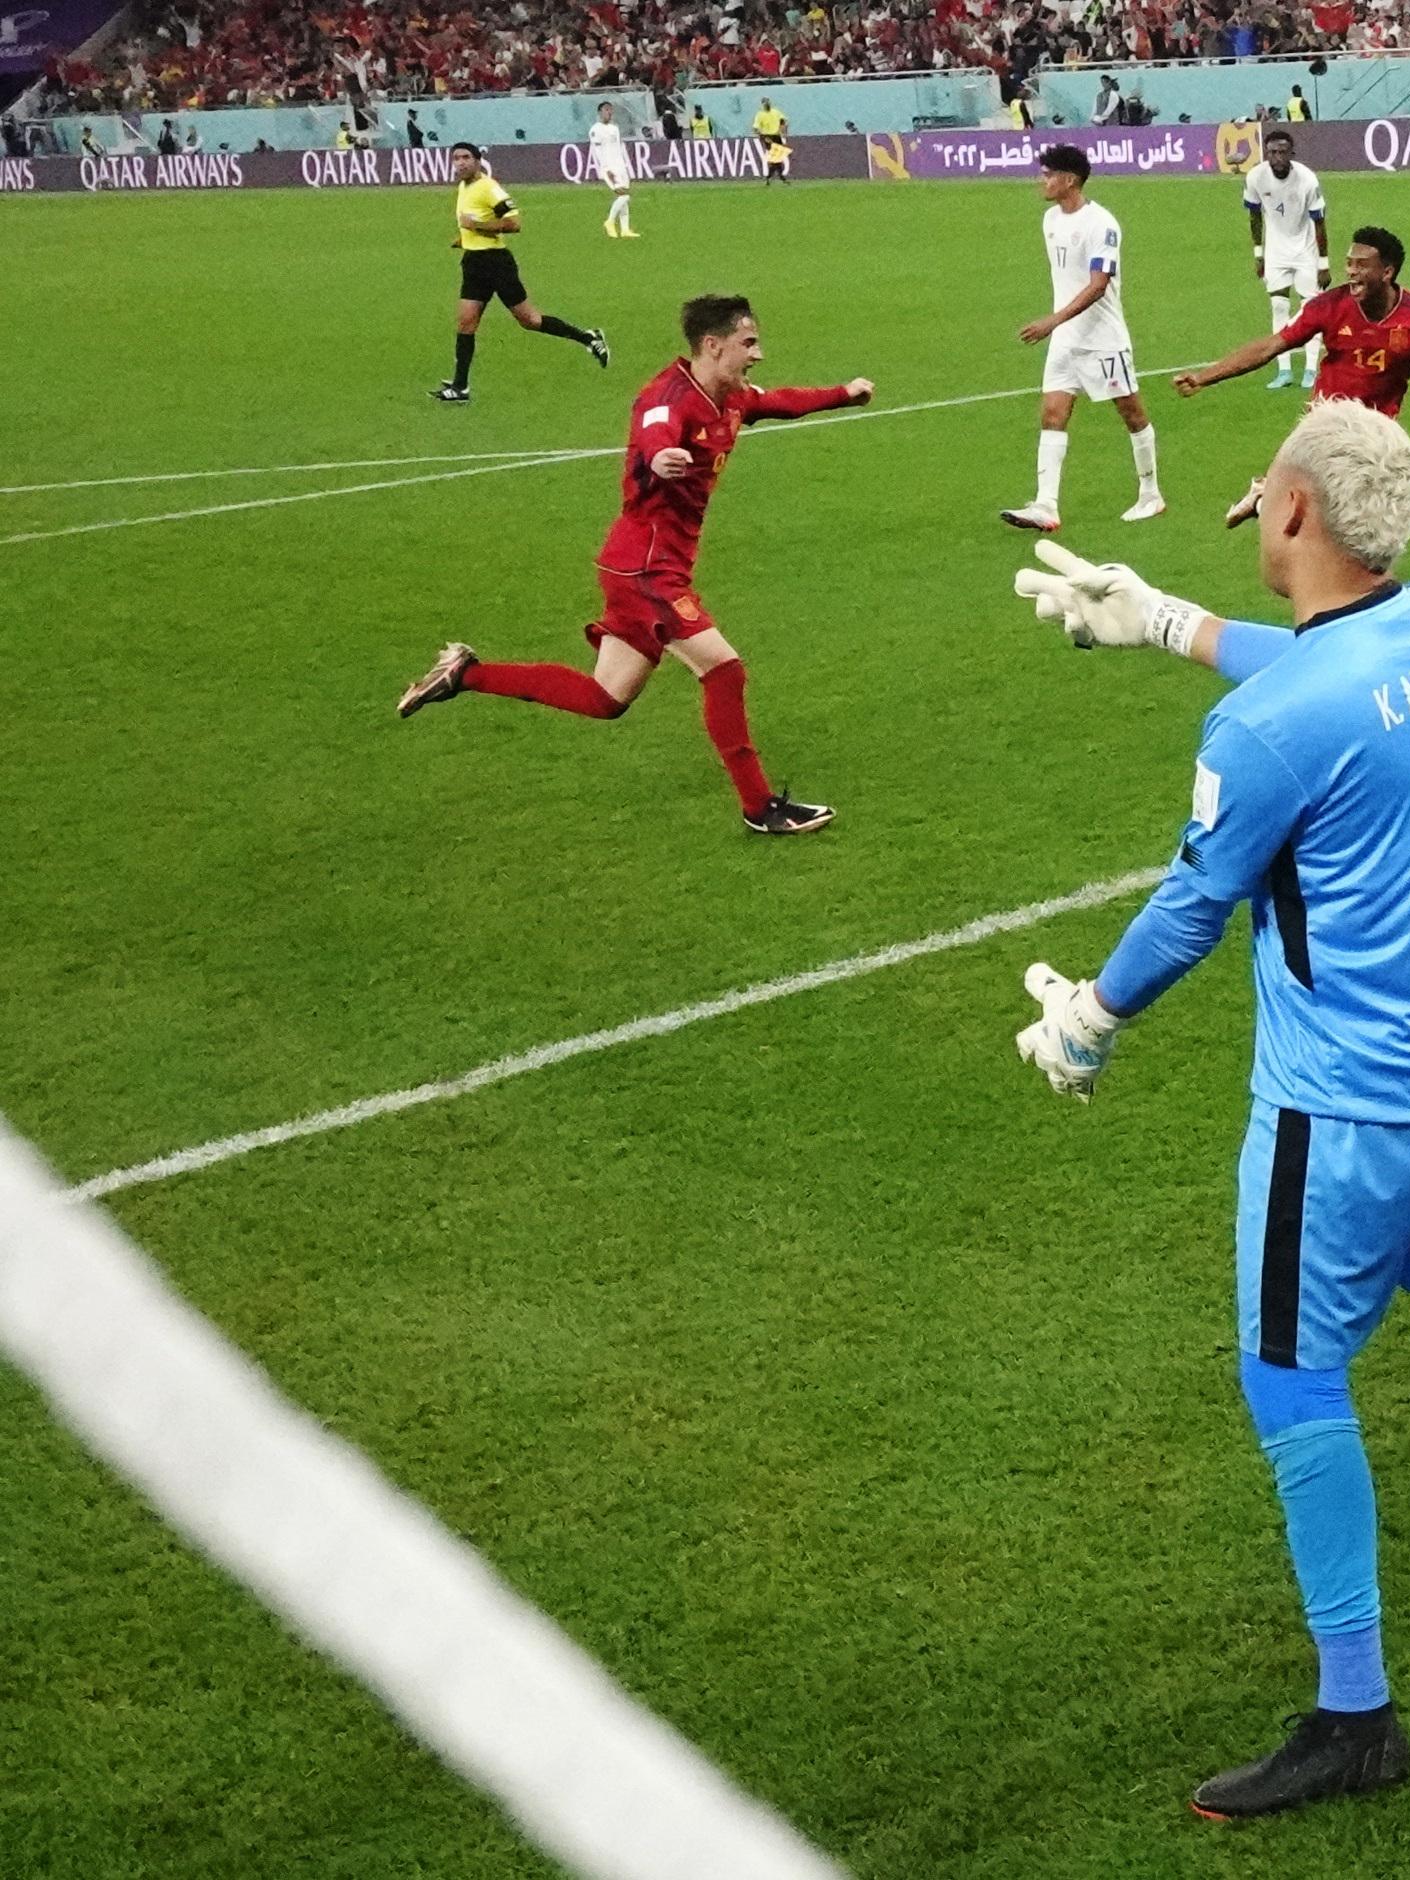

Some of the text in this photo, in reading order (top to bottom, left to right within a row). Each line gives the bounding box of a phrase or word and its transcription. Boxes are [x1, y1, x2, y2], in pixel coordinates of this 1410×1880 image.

[302, 147, 492, 188] QATAR AIRWS
[560, 142, 654, 184] QAAR
[979, 135, 1034, 173] قطر
[1138, 132, 1185, 170] كأس
[0, 158, 35, 190] AYS
[80, 153, 243, 191] QATAR AIRWAYS
[1275, 202, 1285, 218] 4
[1056, 247, 1067, 268] 17
[1099, 357, 1115, 379] 17
[1353, 349, 1386, 373] 14
[1371, 682, 1405, 732] K.
